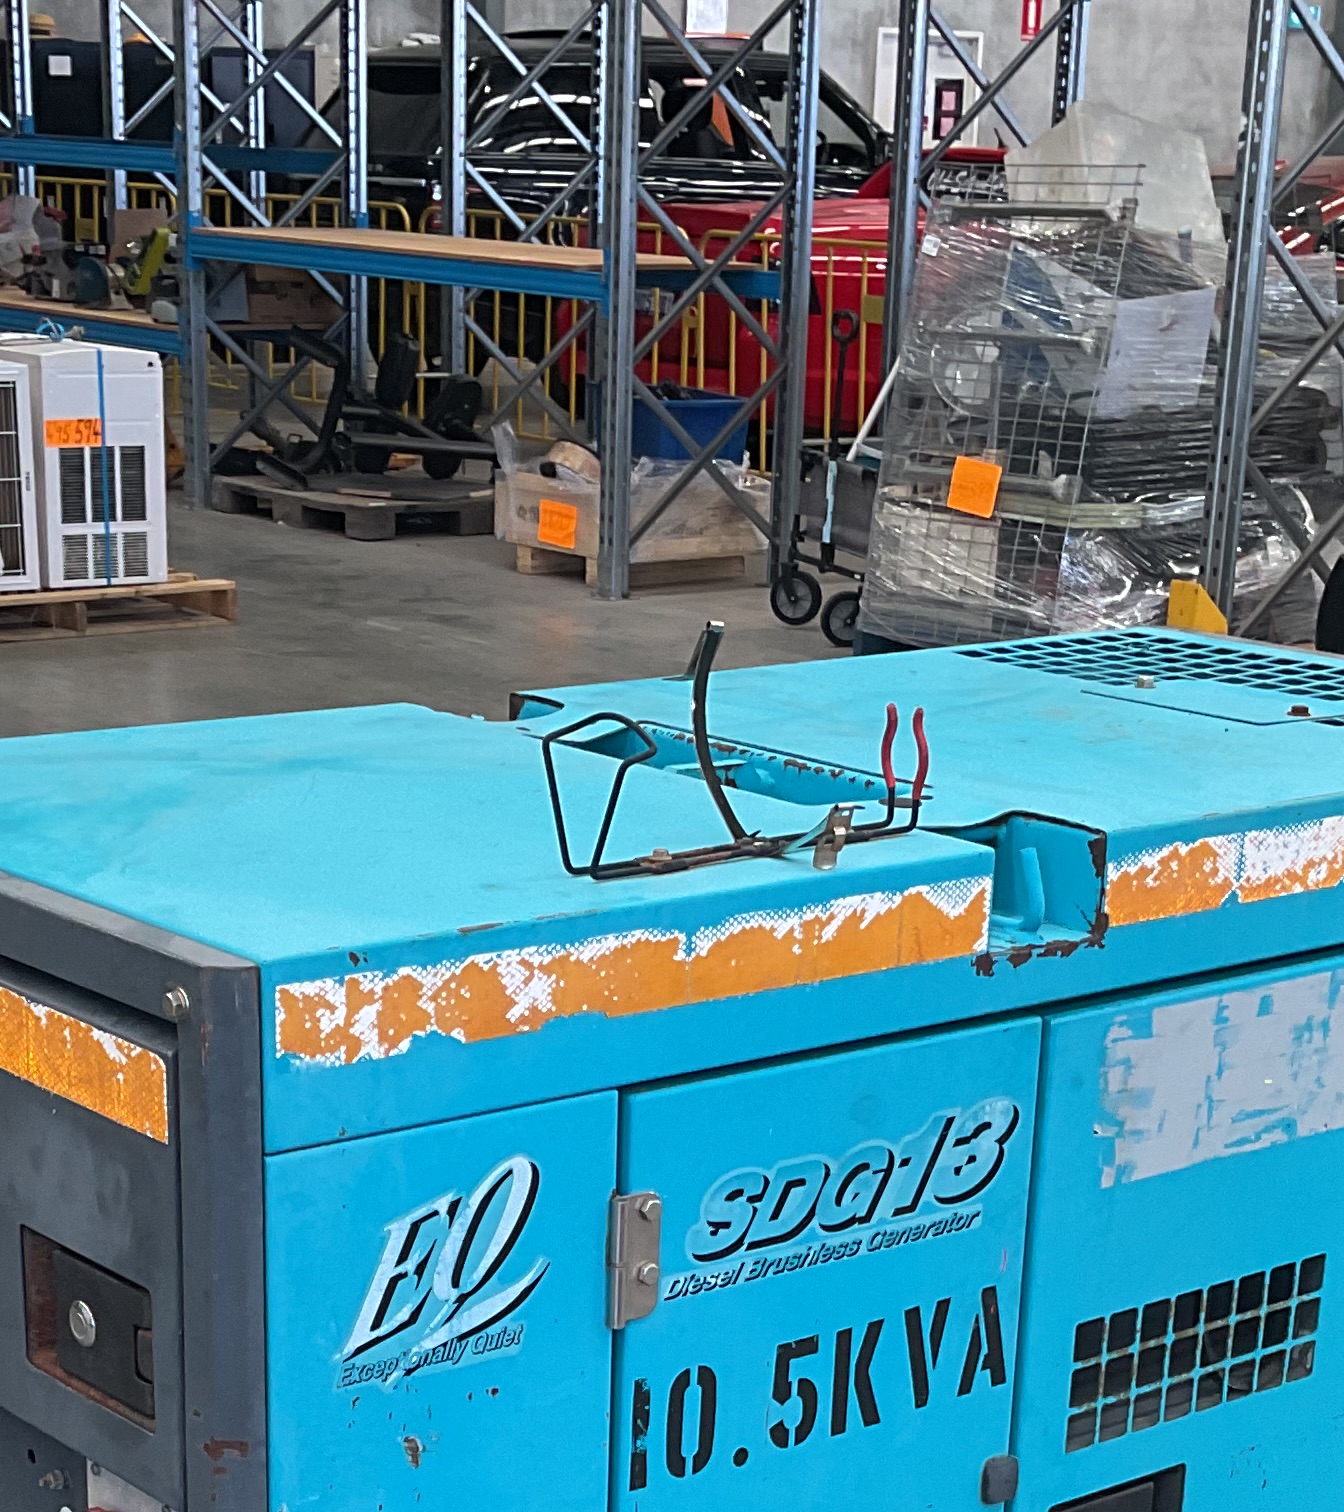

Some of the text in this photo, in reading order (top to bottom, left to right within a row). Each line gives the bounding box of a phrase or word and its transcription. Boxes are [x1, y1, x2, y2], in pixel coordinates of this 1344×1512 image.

[688, 1099, 1020, 1263] SDG13
[663, 1209, 981, 1302] Diesel Brushless Generator
[471, 1324, 524, 1355] Quiet
